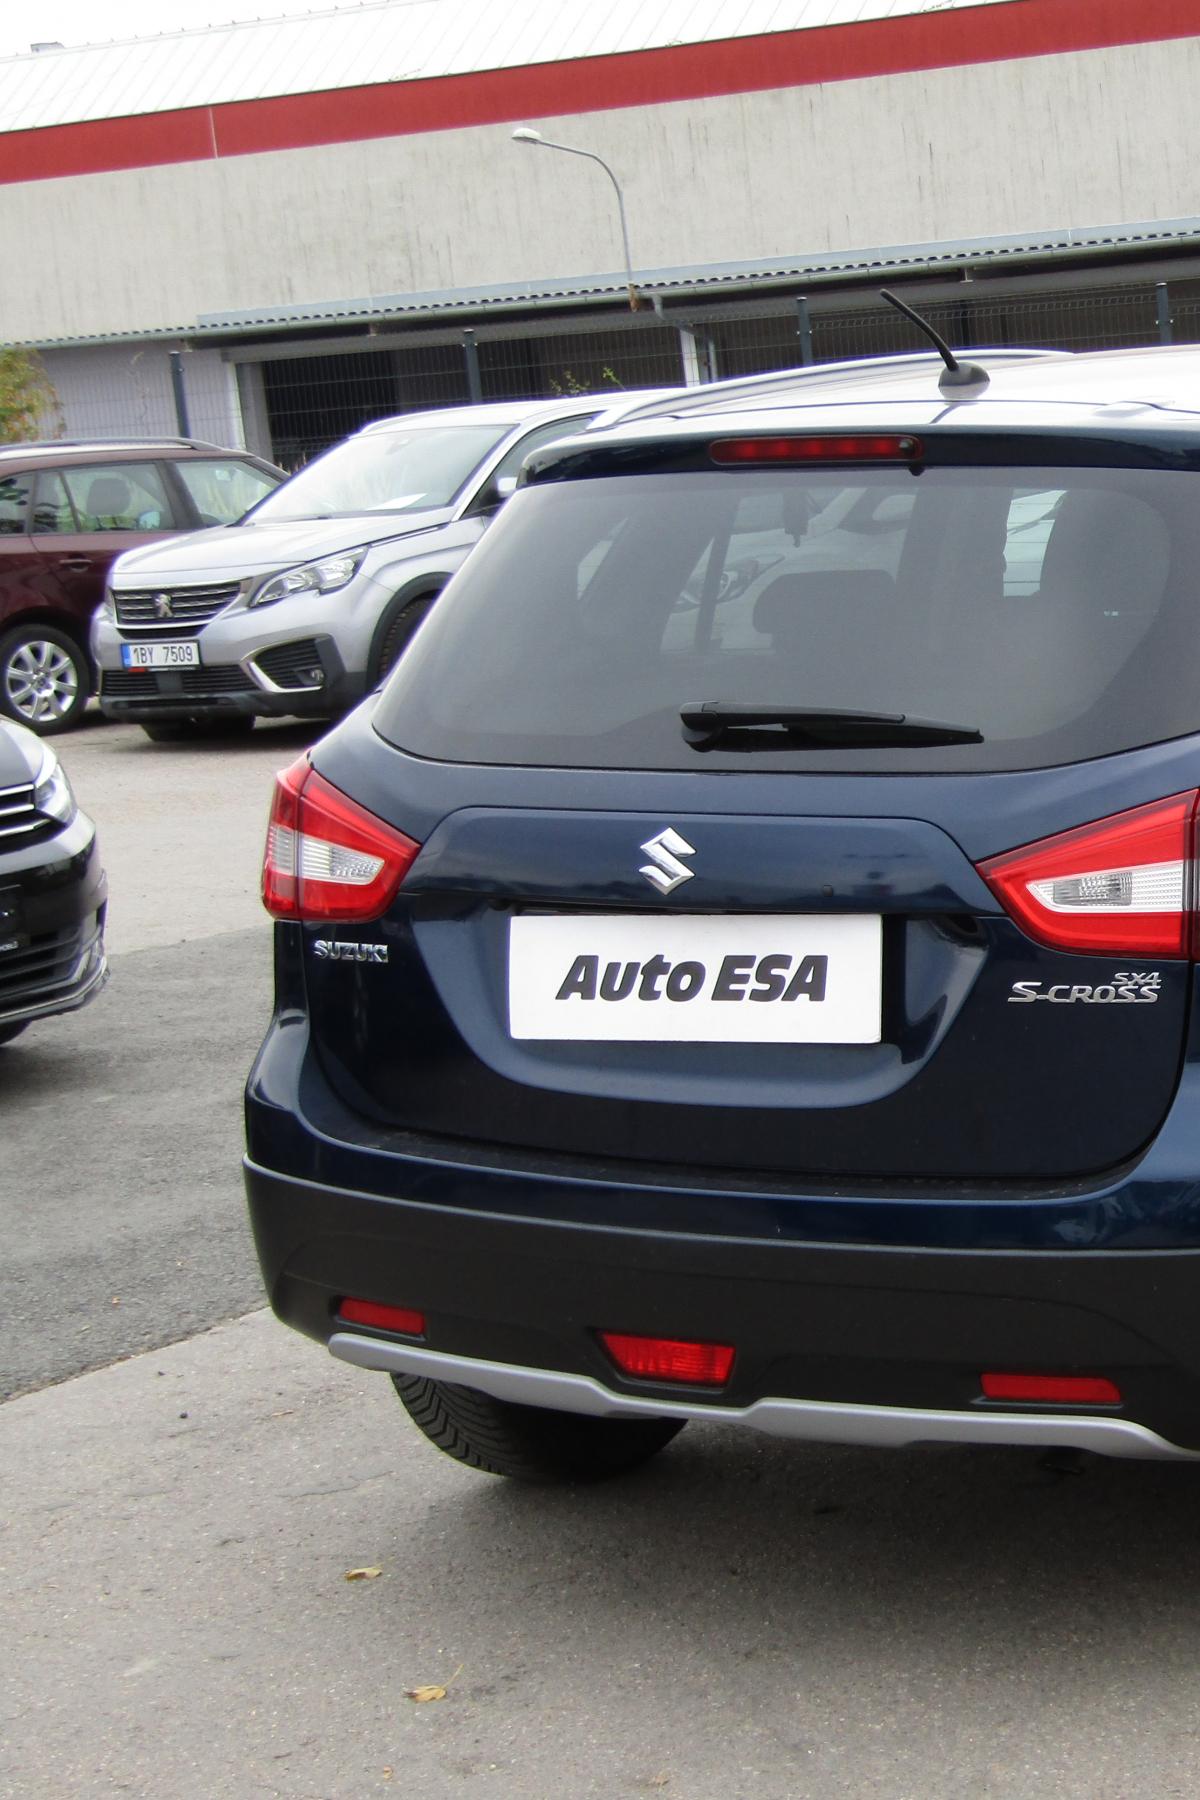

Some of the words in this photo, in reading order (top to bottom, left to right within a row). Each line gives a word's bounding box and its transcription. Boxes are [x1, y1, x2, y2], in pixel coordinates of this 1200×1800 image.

[133, 647, 154, 664] 1BY
[162, 646, 193, 663] 7509
[312, 939, 389, 963] SUZUKI
[555, 954, 706, 1002] Auto
[711, 954, 829, 1002] ESA
[1111, 971, 1162, 987] SX4
[1007, 981, 1162, 1004] S-CROSS
